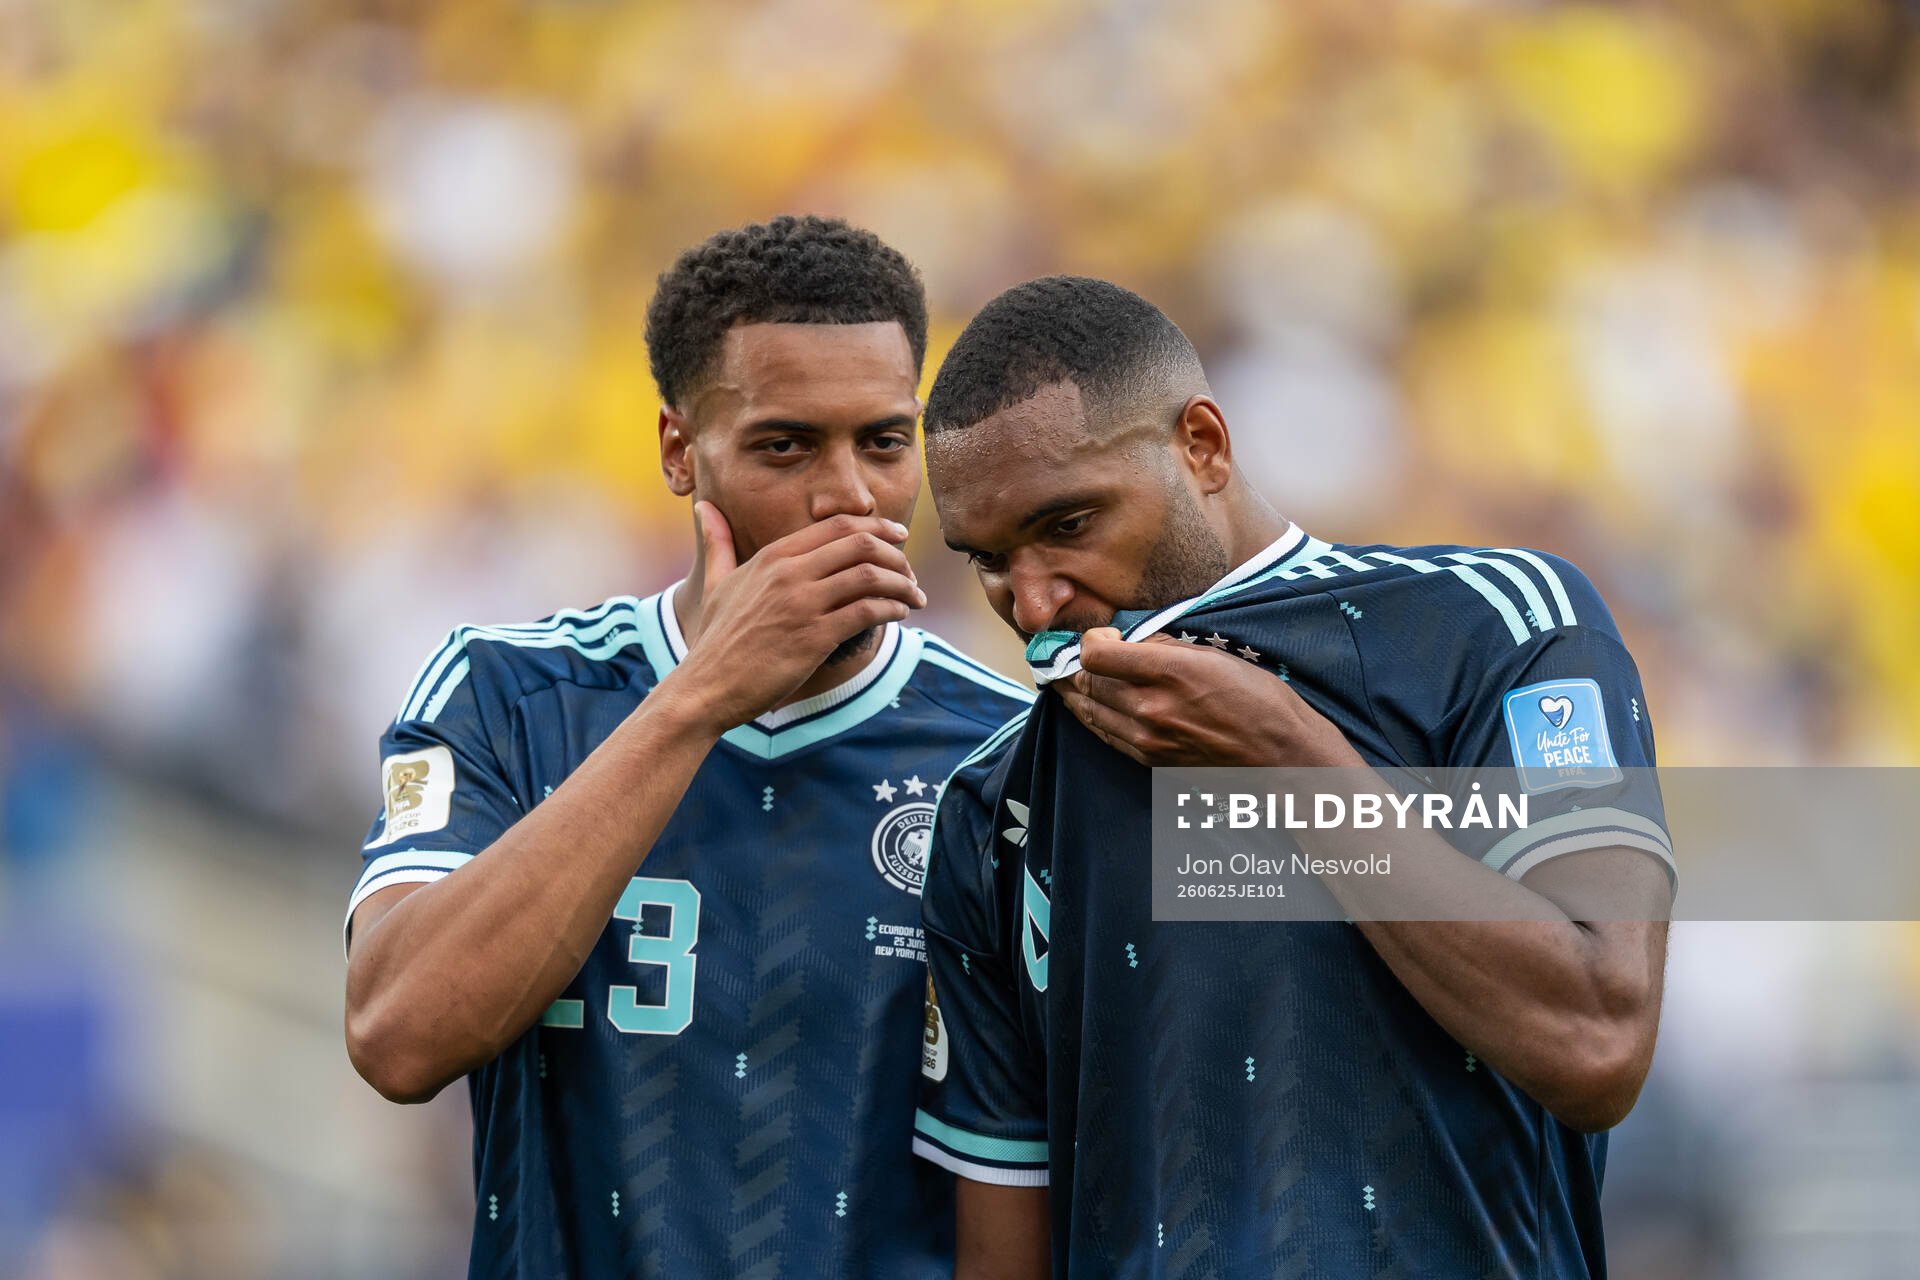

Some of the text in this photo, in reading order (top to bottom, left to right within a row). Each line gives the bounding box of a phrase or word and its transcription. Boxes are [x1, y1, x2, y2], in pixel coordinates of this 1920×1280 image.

[1537, 727, 1590, 752] Unite For
[1544, 746, 1592, 768] PEACE
[1558, 767, 1585, 777] FIFA
[897, 814, 934, 829] DEUTS
[888, 854, 924, 882] FUSSBA
[879, 925, 914, 937] ECUADOR
[894, 936, 905, 946] 25
[875, 945, 894, 956] NEW
[895, 948, 915, 960] YORK
